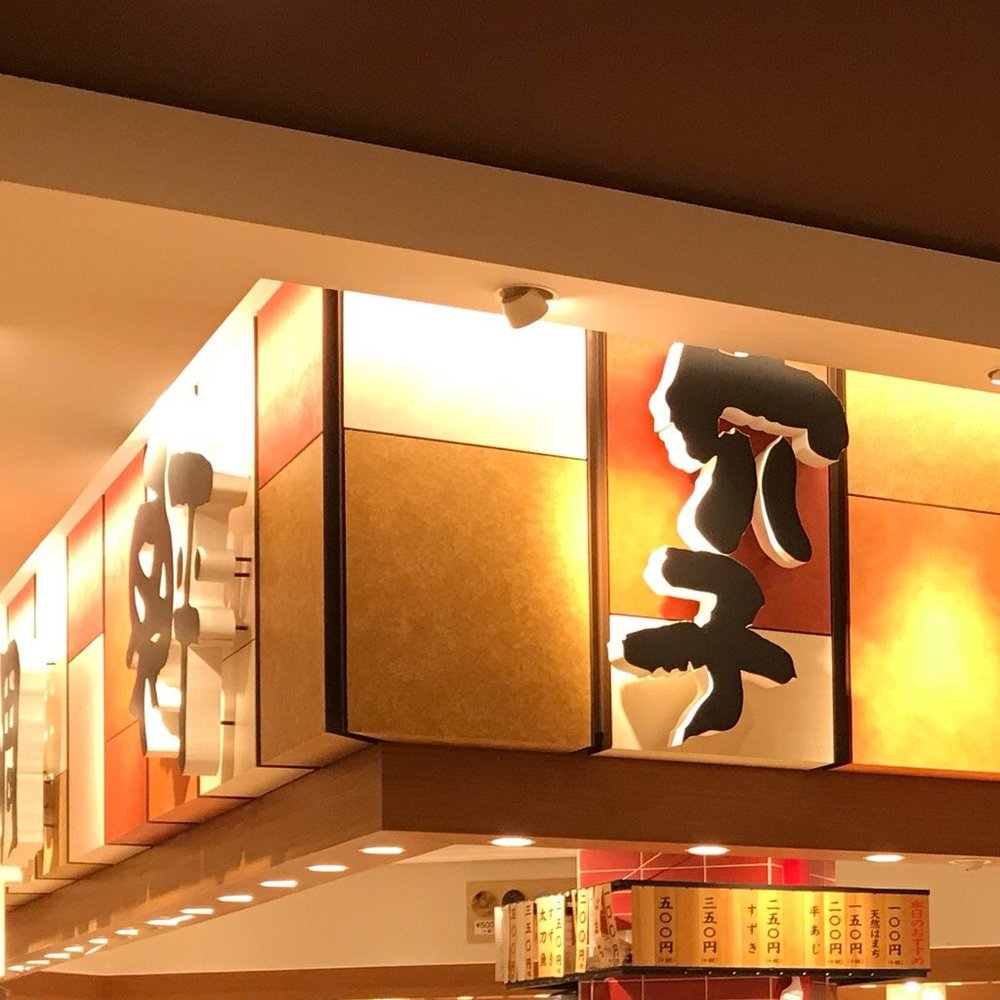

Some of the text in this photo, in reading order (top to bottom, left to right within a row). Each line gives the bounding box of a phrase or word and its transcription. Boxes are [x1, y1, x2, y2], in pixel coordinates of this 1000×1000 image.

[539, 908, 547, 968] 太刀魚
[658, 896, 674, 954] 五〇〇円
[702, 896, 718, 954] 三五〇円
[747, 903, 758, 955] すずき
[766, 899, 781, 955] 二五〇円
[809, 904, 821, 956] 平あじ
[828, 901, 843, 956] 二〇〇円
[848, 904, 863, 956] 一五〇円
[869, 908, 881, 959] 天然はまち
[887, 905, 903, 957] 一〇〇円
[909, 899, 925, 966] 本日のおすすめ
